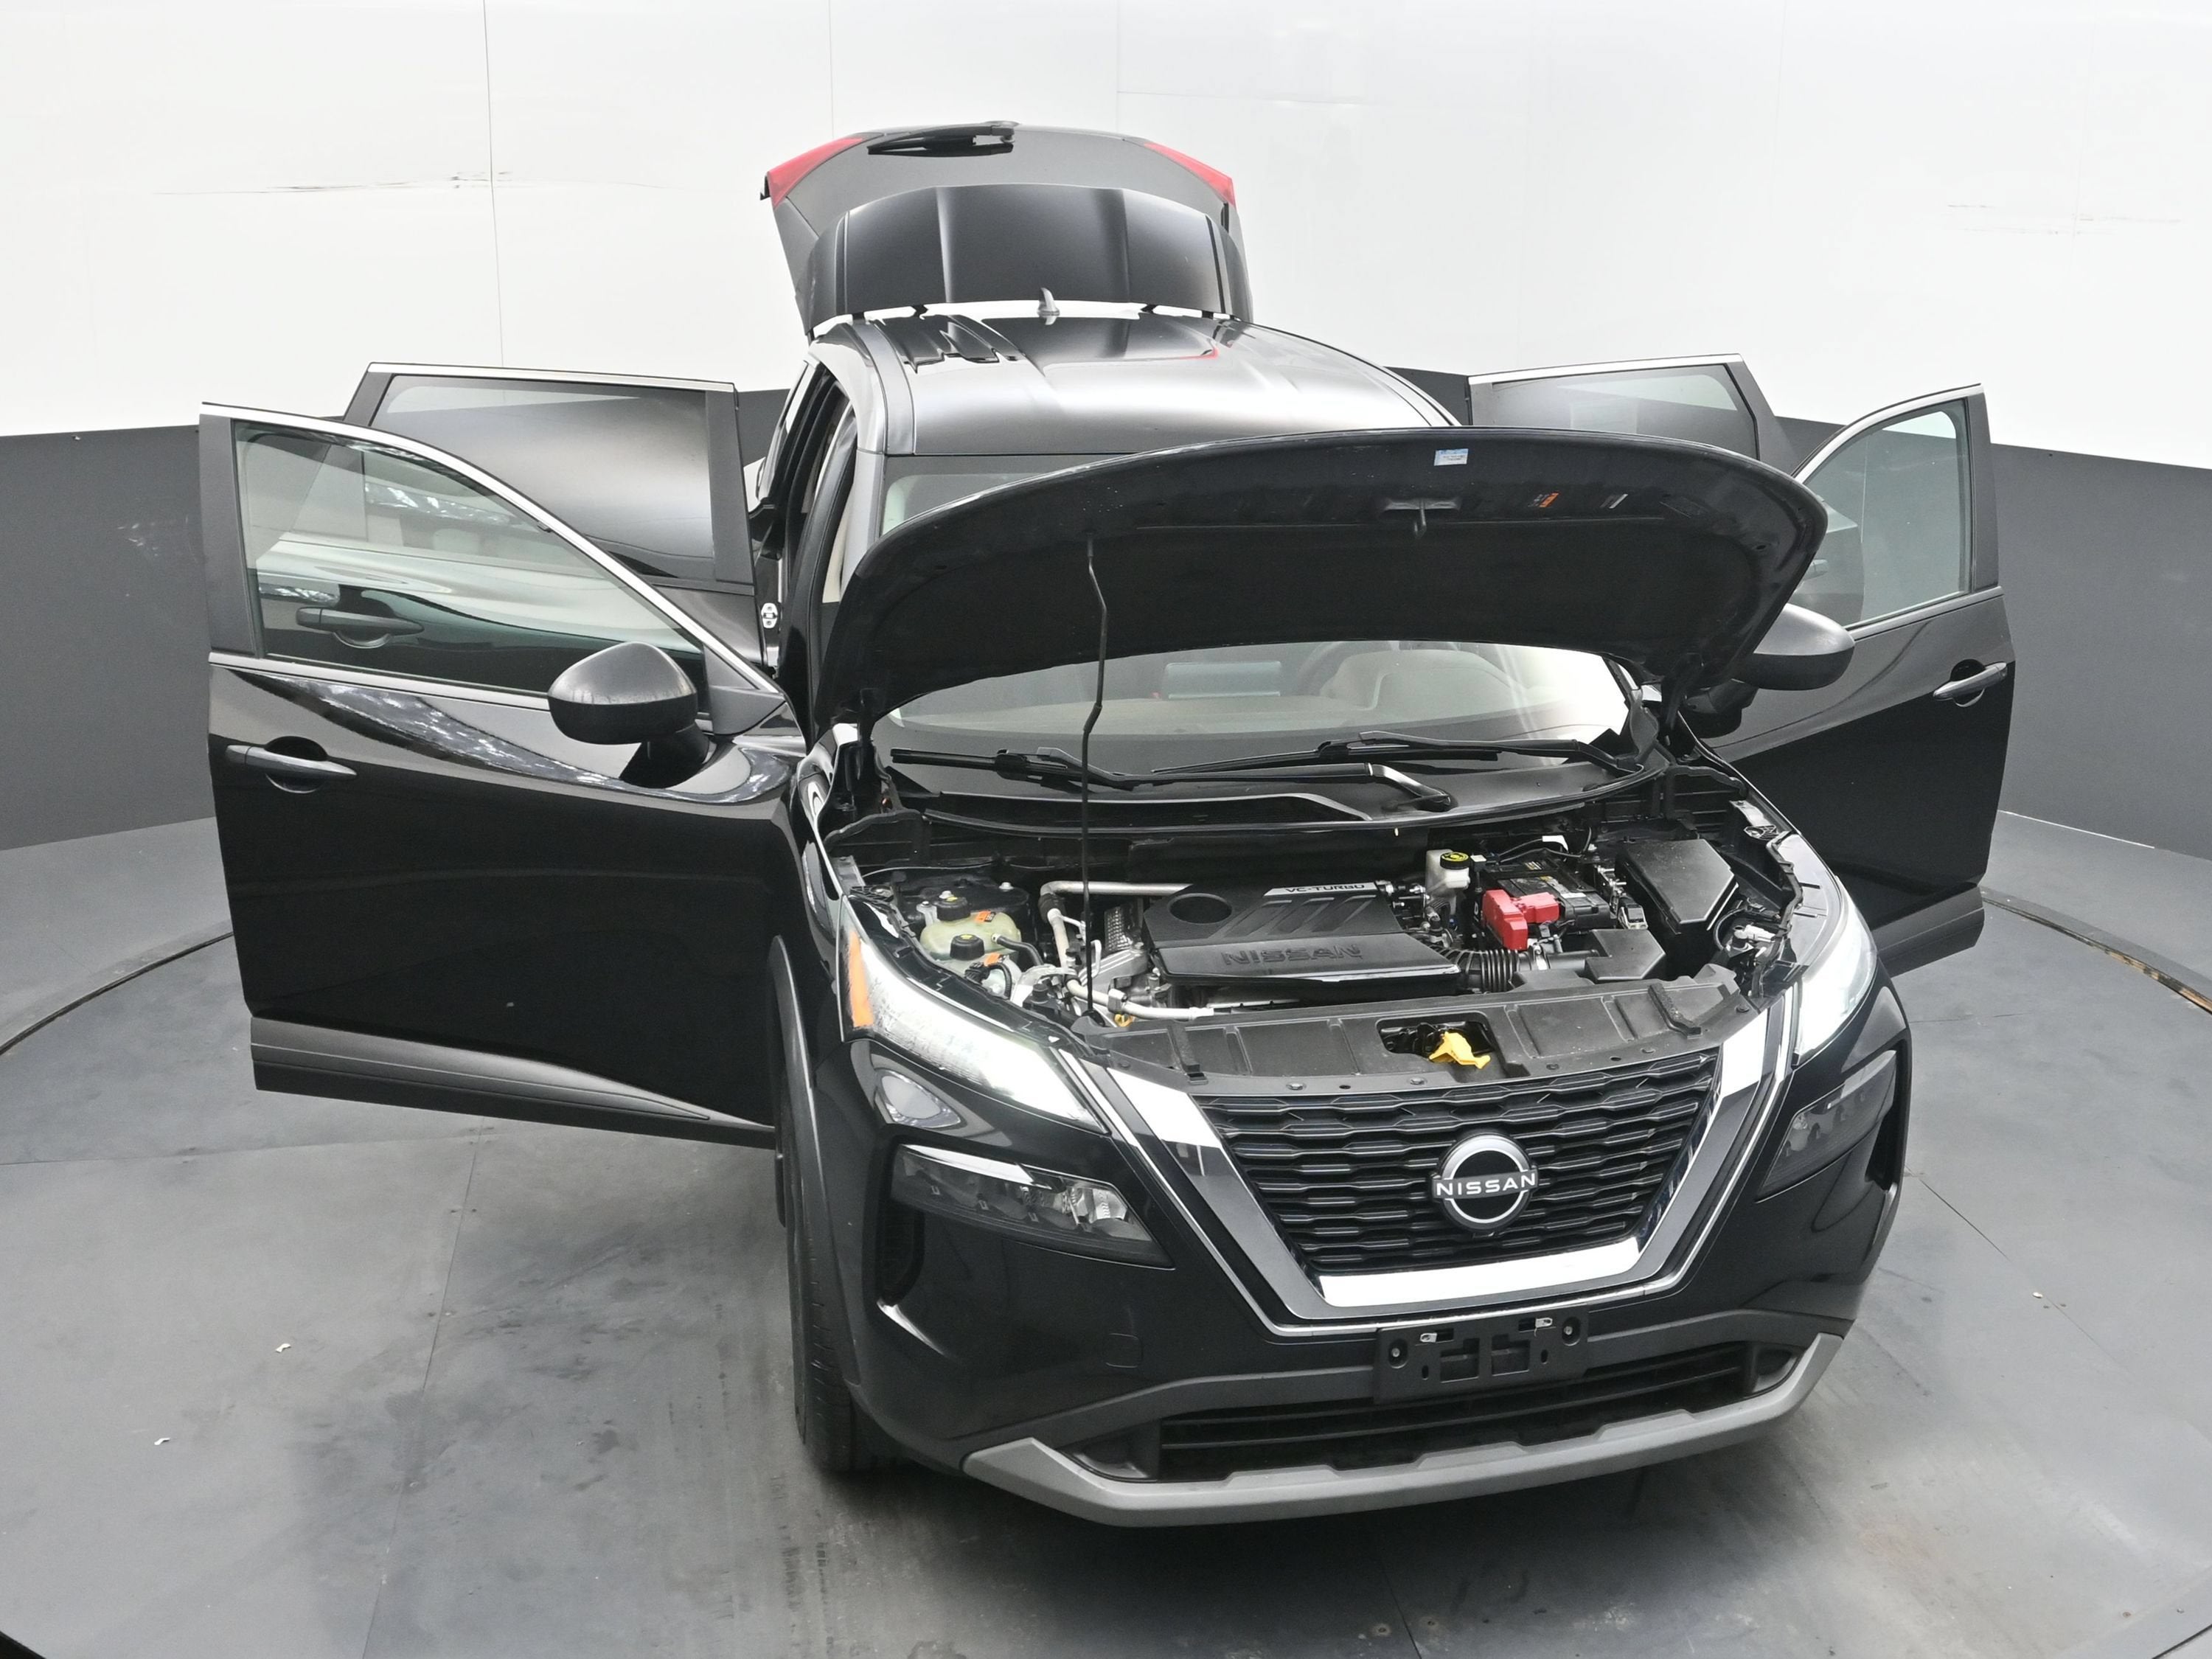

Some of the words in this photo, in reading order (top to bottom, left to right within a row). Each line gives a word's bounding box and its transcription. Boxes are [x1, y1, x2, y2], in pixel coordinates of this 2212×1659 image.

[1286, 884, 1366, 893] VC-TURBO
[1221, 944, 1363, 966] NISSAN
[1436, 1172, 1536, 1196] NISSAN
